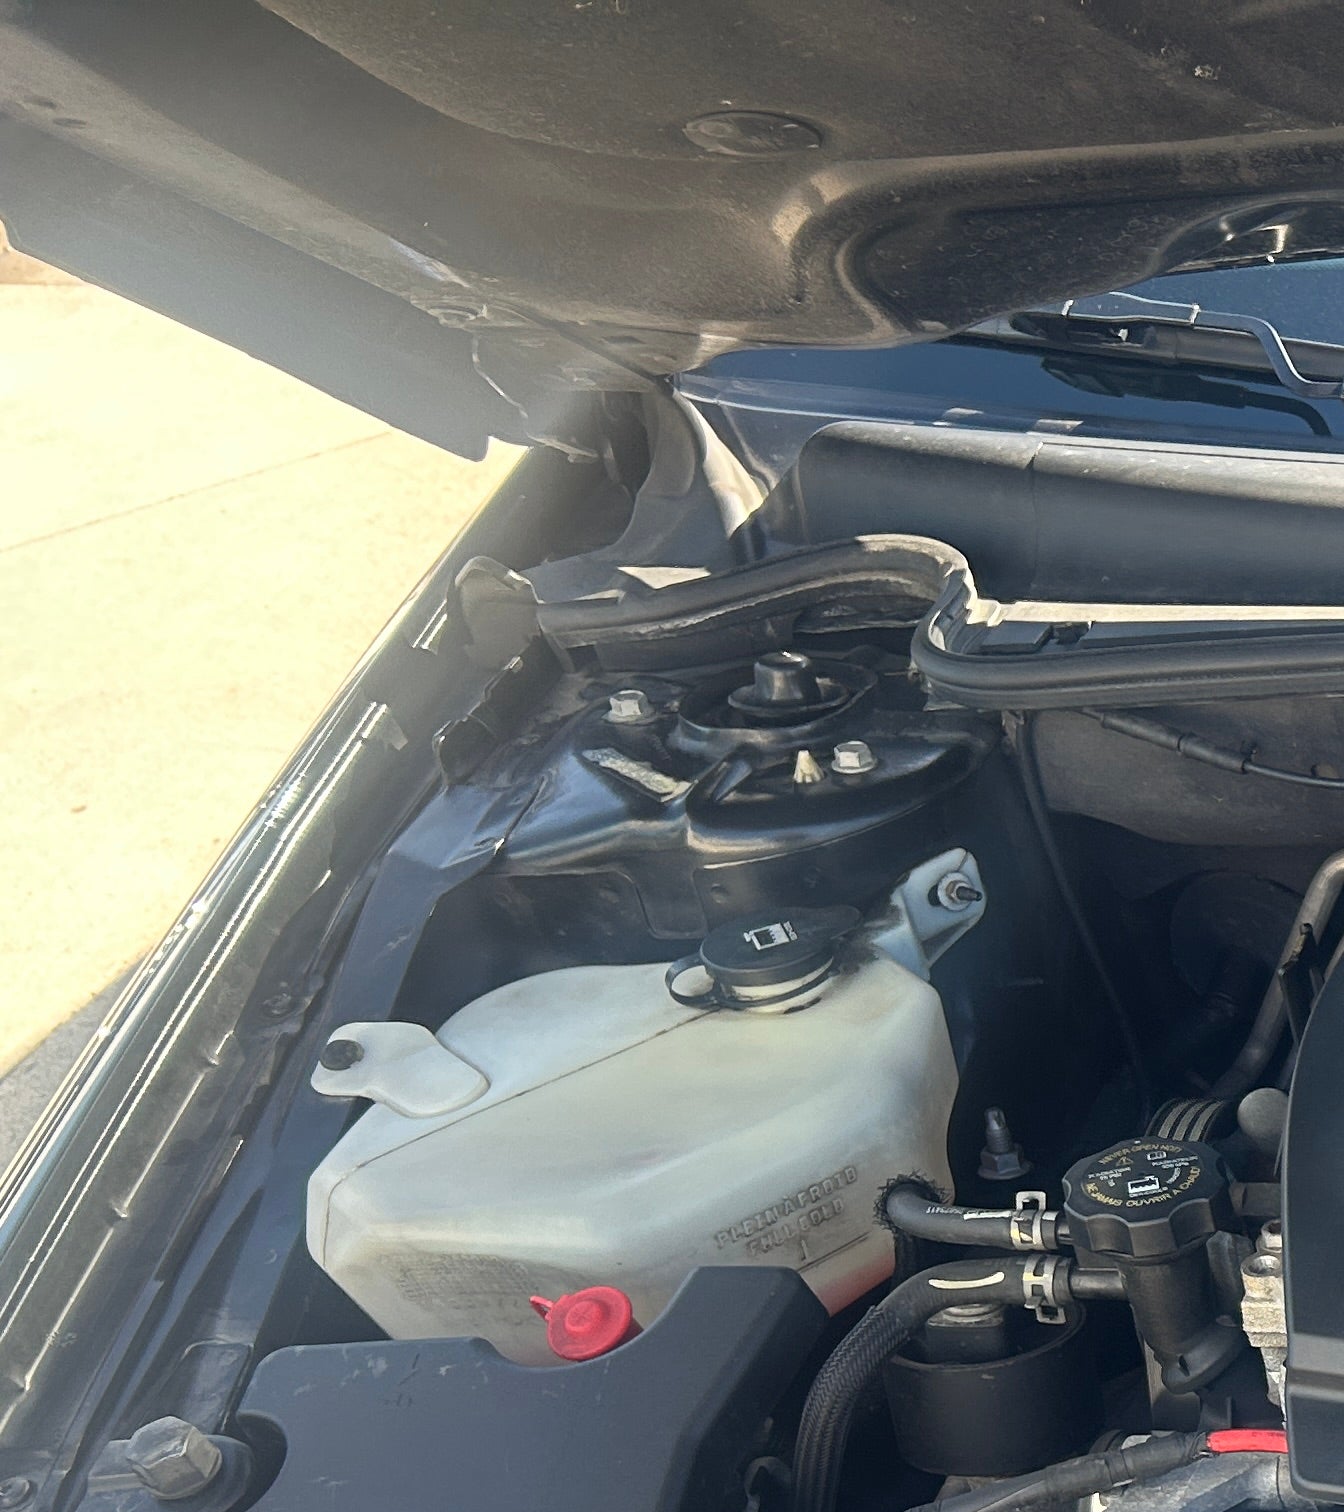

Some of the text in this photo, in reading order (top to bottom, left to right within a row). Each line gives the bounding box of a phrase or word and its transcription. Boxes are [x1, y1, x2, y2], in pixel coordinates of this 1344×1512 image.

[714, 1206, 780, 1250] PLEIN
[796, 1166, 858, 1207] FROID
[1125, 1193, 1172, 1208] OUVRIR
[746, 1224, 797, 1257] FULL
